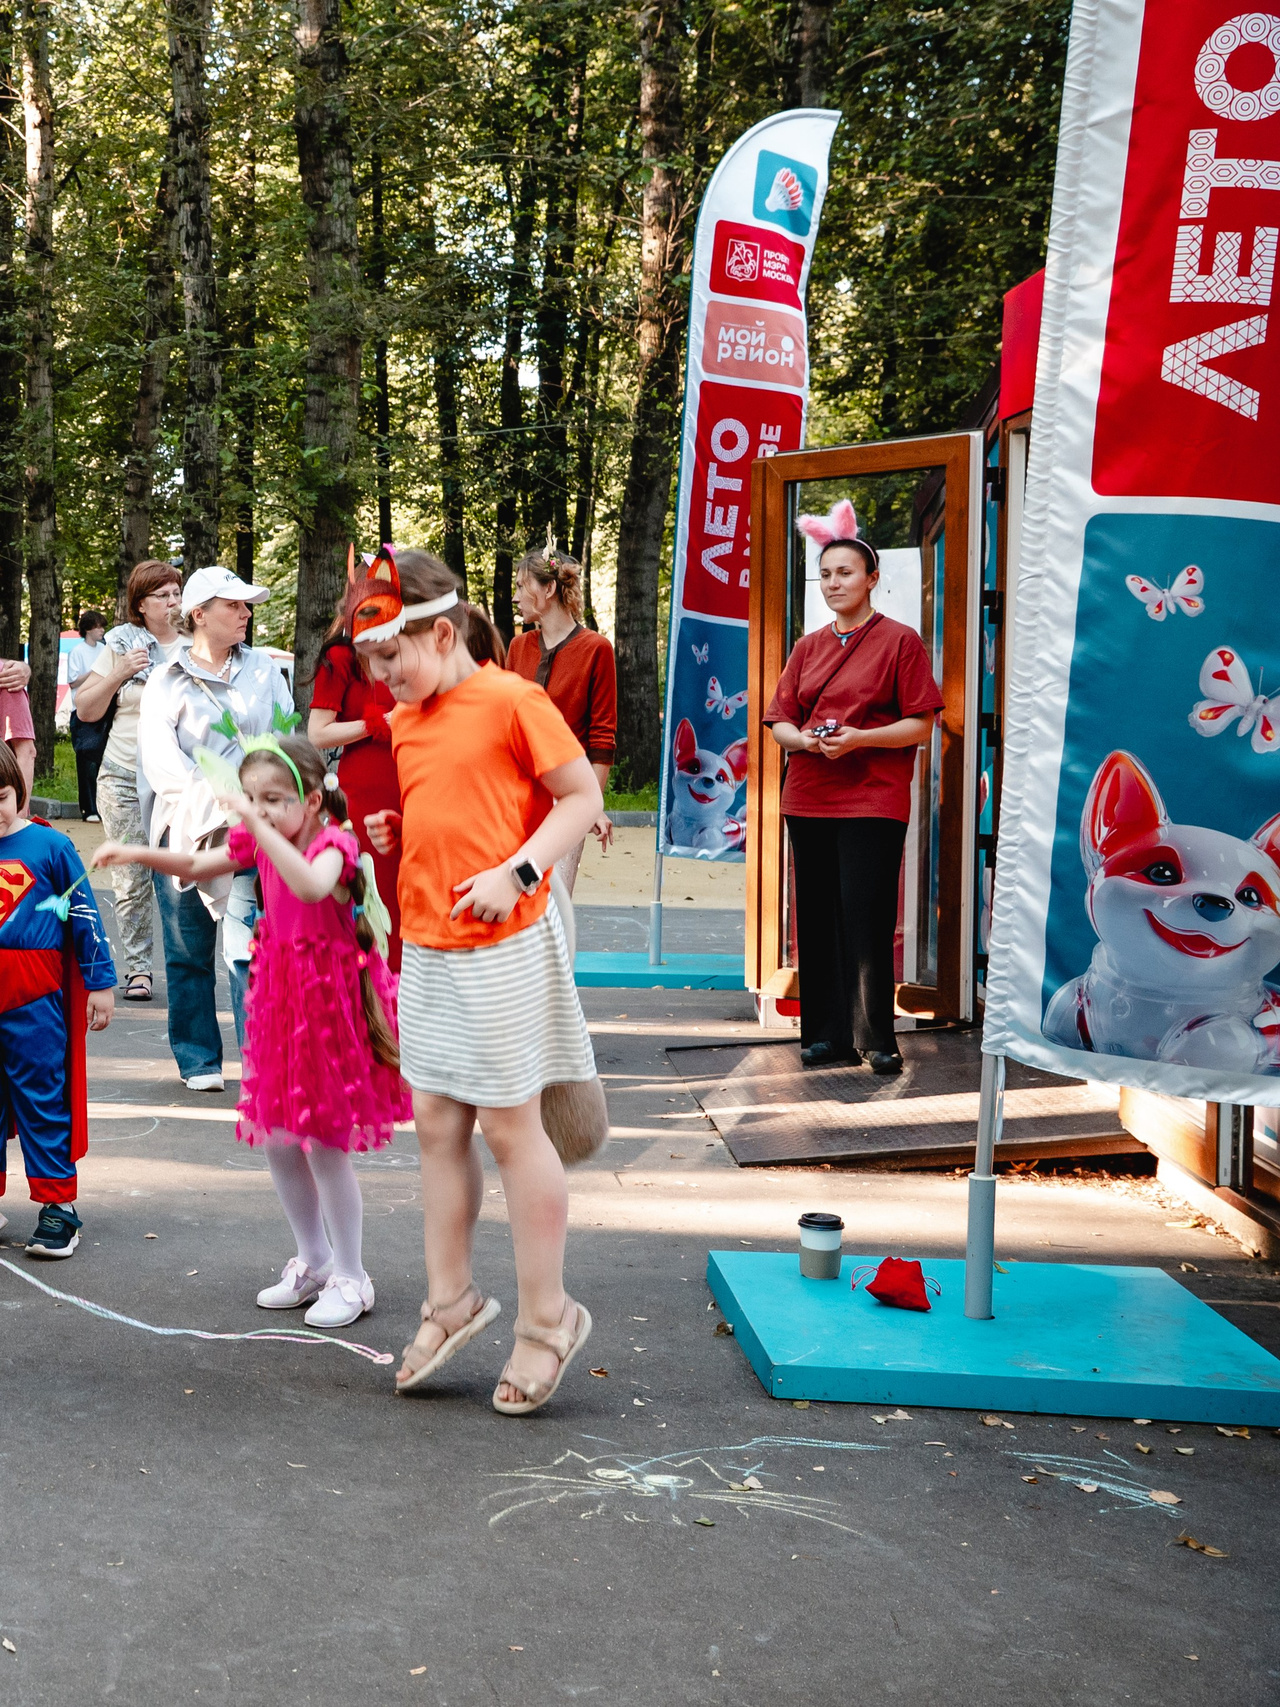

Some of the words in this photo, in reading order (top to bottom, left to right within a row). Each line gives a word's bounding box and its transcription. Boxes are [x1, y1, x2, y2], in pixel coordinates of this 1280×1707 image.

[763, 259, 787, 272] МЭРА
[1160, 12, 1280, 422] ЛЕТО
[701, 418, 750, 585] ЛЕТО
